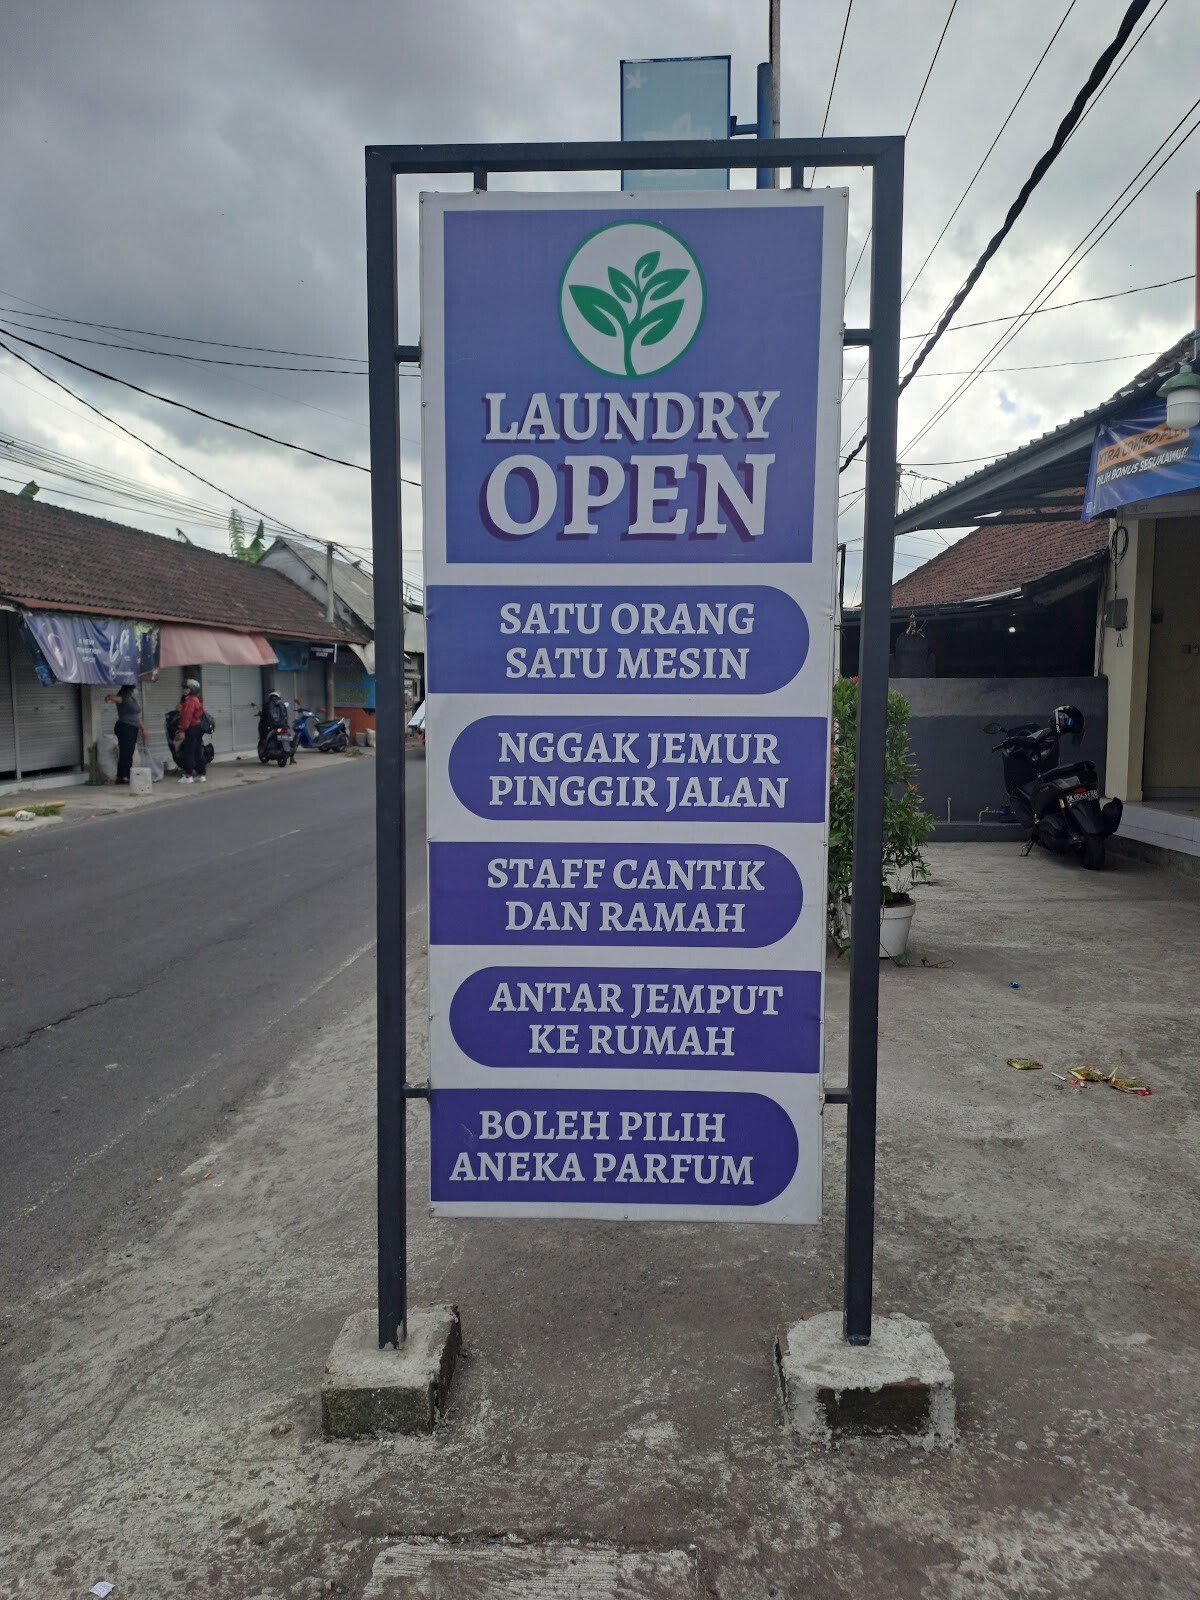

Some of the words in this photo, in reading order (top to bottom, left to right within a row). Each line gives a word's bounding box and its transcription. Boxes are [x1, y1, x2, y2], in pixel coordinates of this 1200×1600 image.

[486, 391, 780, 441] LAUNDRY
[1111, 463, 1139, 479] BONUS
[487, 454, 775, 535] OPEN
[500, 603, 602, 634] SATU
[611, 603, 754, 634] ORANG
[506, 648, 607, 678] SATU
[617, 648, 749, 679] MESIN
[499, 733, 639, 763] NGGAK
[647, 733, 780, 769] JEMUR
[489, 776, 658, 807] PINGGIR
[666, 777, 788, 812] JALAN
[488, 858, 605, 888] STAFF
[613, 860, 765, 890] CANTIK
[506, 901, 590, 931] DAN
[599, 902, 745, 932] RAMAH
[489, 983, 624, 1012] ANTAR
[631, 984, 783, 1018] JEMPUT
[529, 1025, 579, 1053] KE
[589, 1025, 734, 1056] RUMAH
[479, 1111, 609, 1140] BOLEH
[619, 1112, 725, 1142] PILIH
[449, 1152, 585, 1181] ANEKA
[593, 1153, 754, 1184] PARFUM
